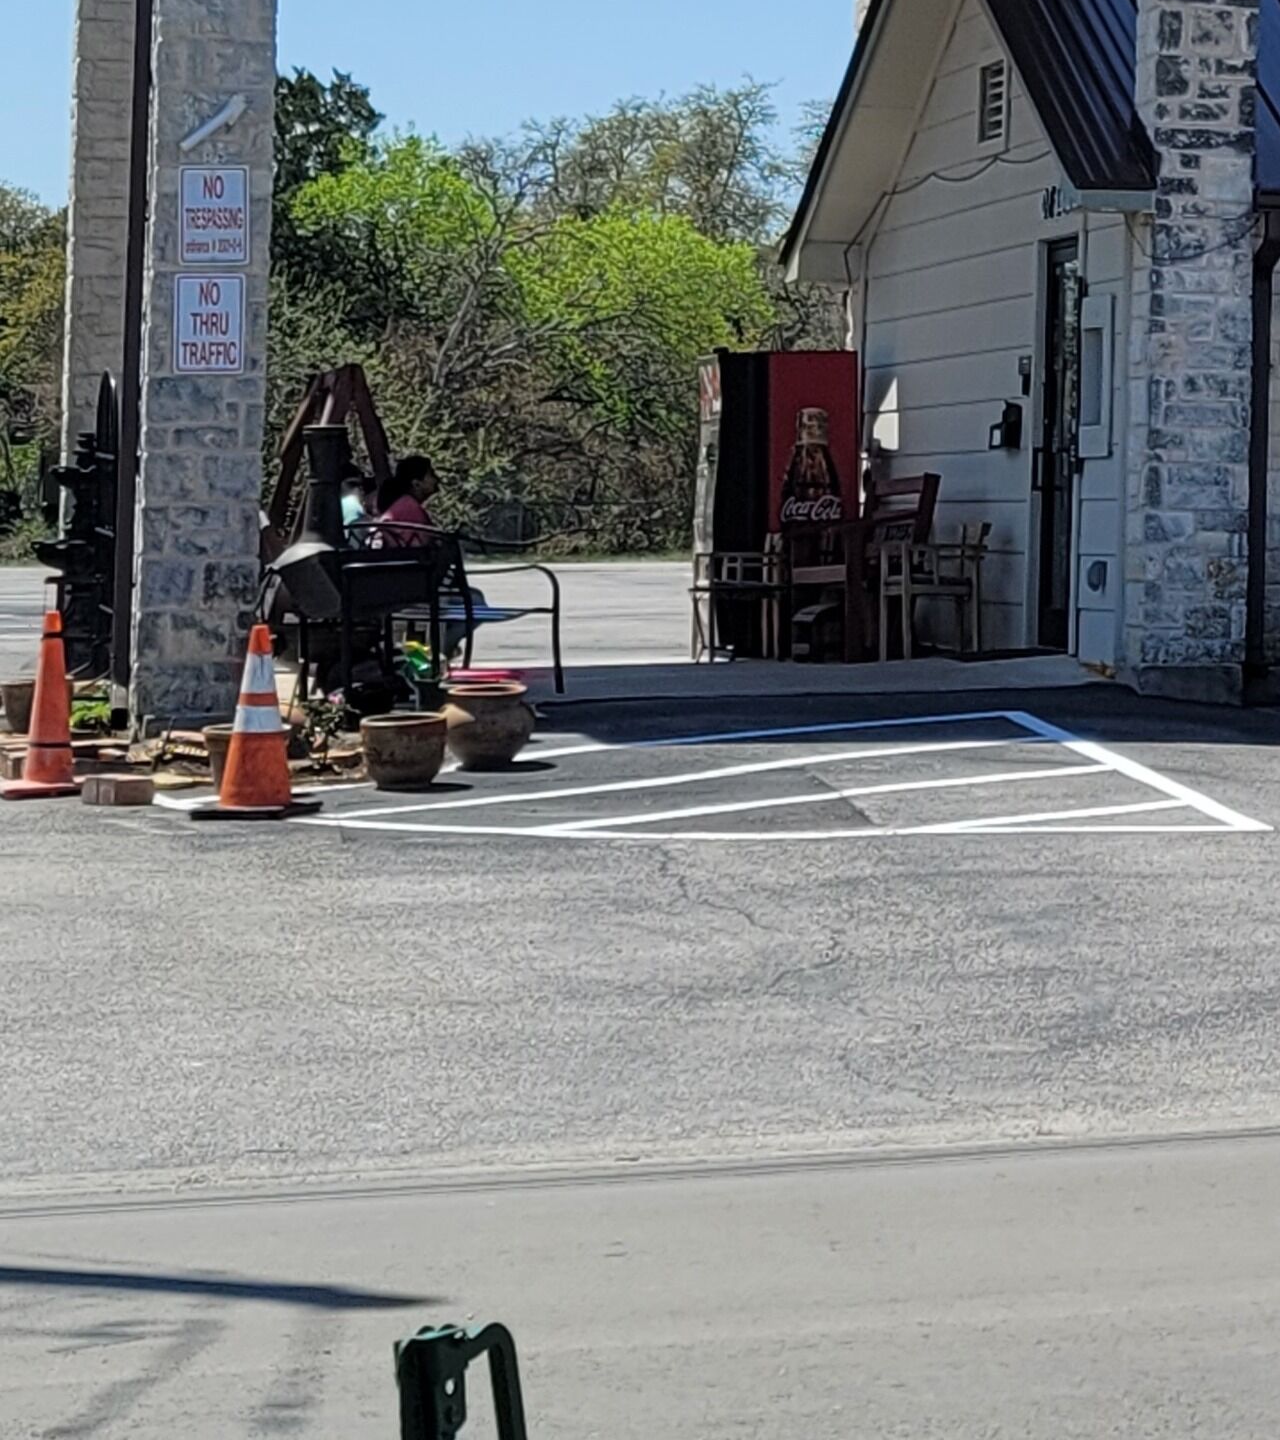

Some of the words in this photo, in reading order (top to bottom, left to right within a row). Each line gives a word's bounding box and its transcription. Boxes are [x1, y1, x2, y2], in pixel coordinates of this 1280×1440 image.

[203, 175, 225, 199] NO
[185, 207, 243, 230] TRESPASSING
[199, 282, 221, 306] NO
[190, 312, 230, 336] THRU
[181, 341, 237, 365] TRAFFIC
